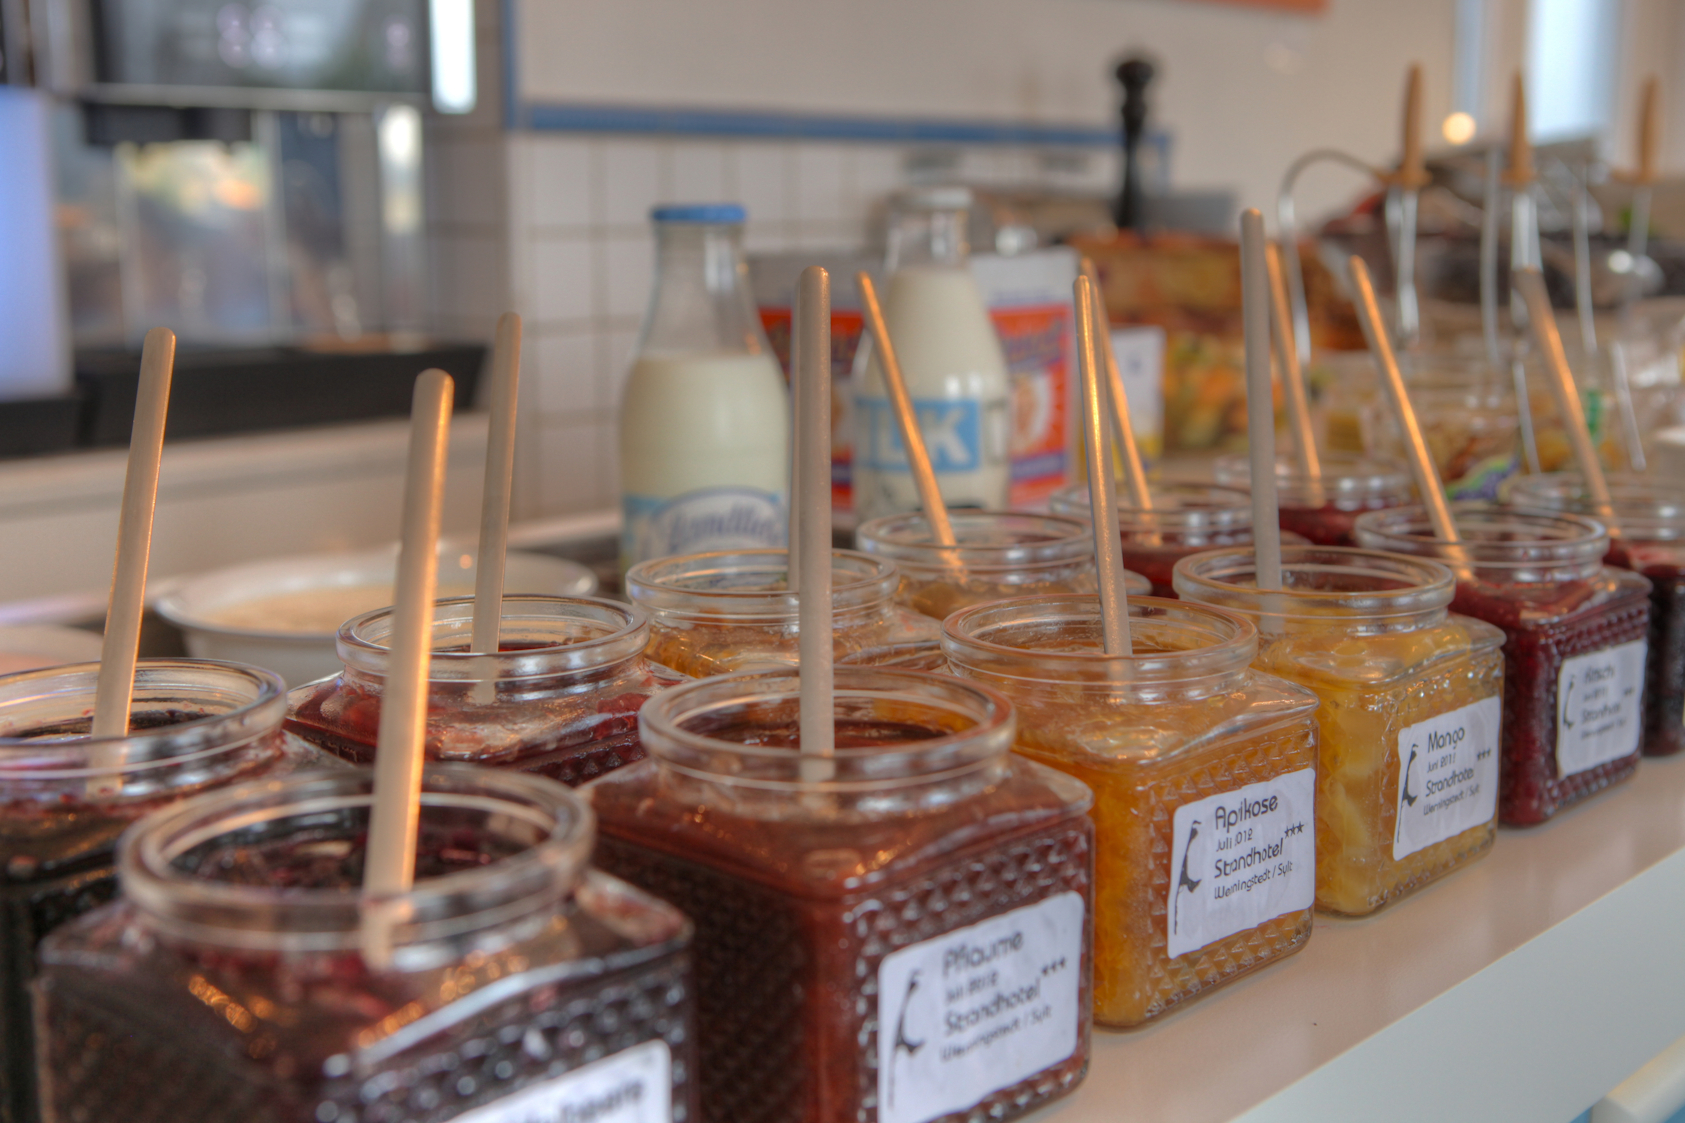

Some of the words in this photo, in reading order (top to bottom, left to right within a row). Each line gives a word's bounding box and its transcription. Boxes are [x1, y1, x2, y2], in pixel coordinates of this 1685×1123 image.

[1427, 726, 1465, 753] Mango
[1425, 767, 1475, 797] Strandhote
[1215, 795, 1278, 833] Aprikose
[1216, 837, 1233, 853] Juli
[1234, 828, 1253, 847] 012
[1214, 838, 1284, 879] Strandhotel
[943, 931, 1024, 978] Pflaume
